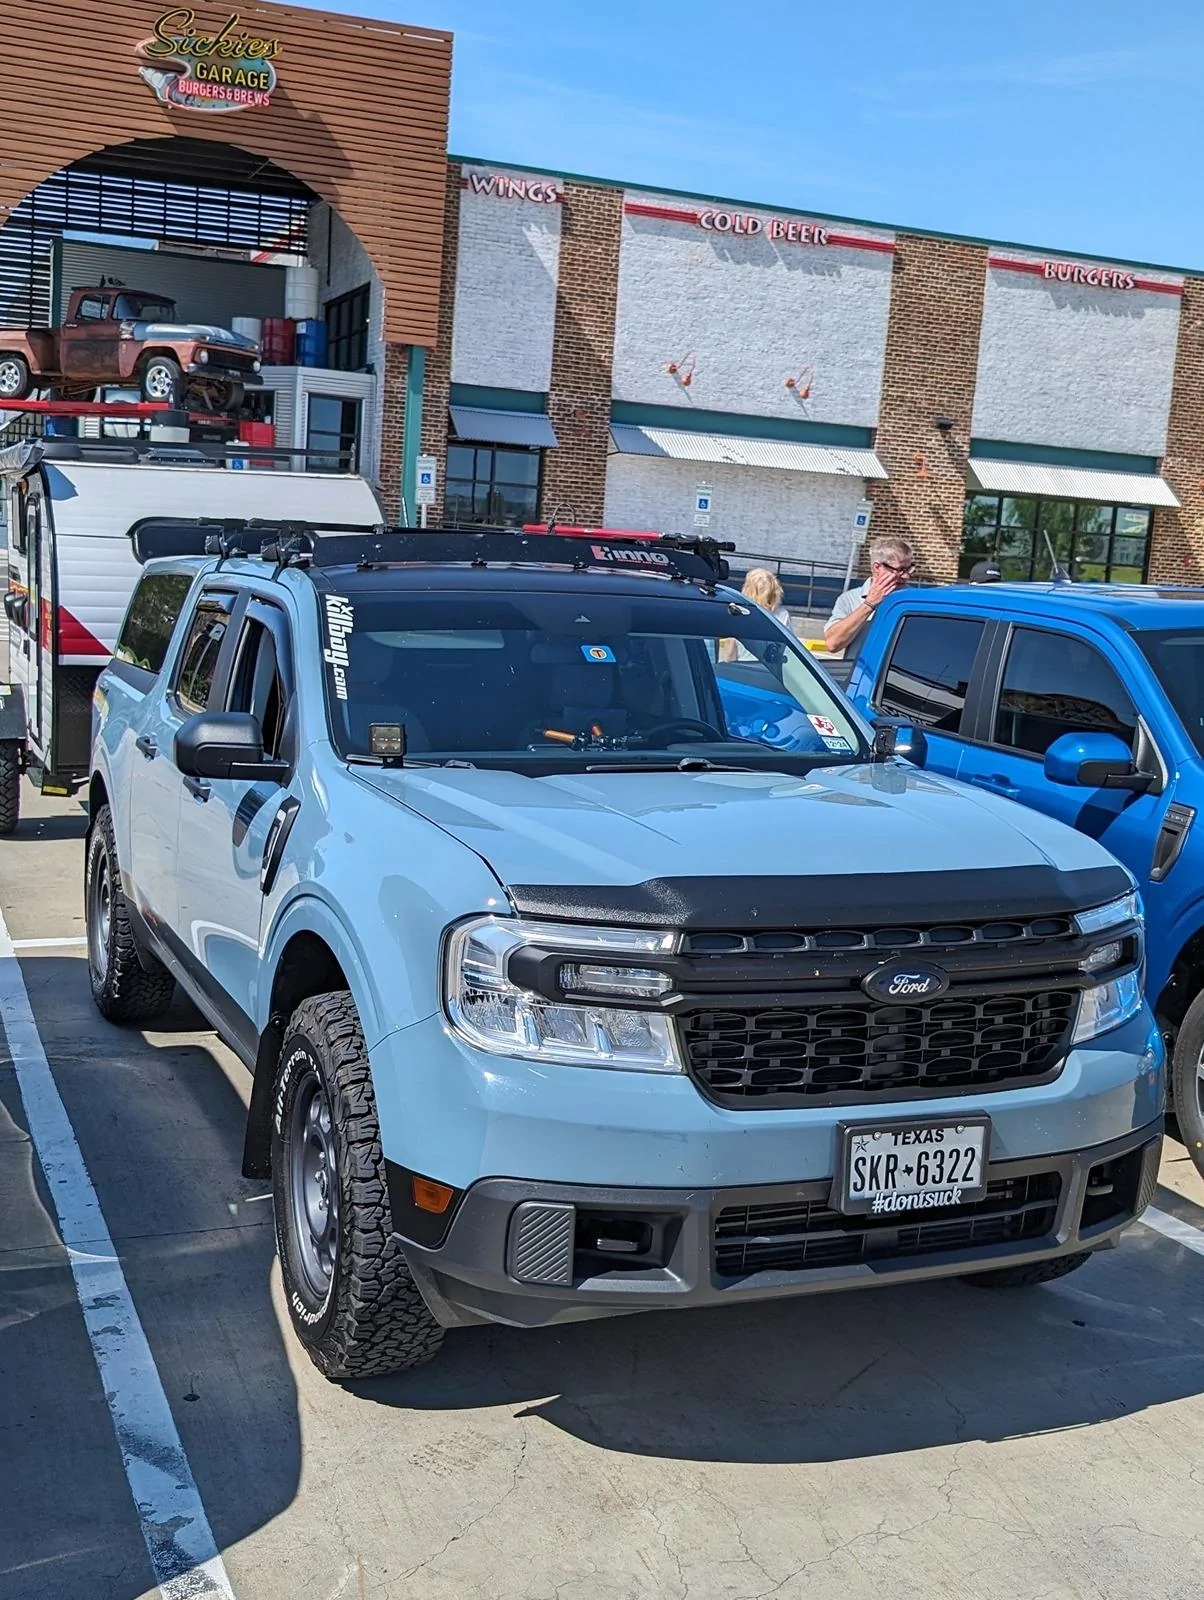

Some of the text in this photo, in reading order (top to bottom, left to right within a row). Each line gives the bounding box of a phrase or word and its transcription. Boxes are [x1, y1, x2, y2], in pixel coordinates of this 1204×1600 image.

[145, 8, 282, 59] Sickies
[196, 62, 269, 90] GARAGE
[470, 173, 558, 204] WINGS
[700, 211, 829, 245] COLD BEER
[1043, 261, 1136, 290] BURGERS
[324, 593, 354, 700] killboy.com
[889, 974, 931, 995] Ford
[891, 1128, 945, 1147] TEXAS
[871, 1186, 962, 1213] #dontsuck
